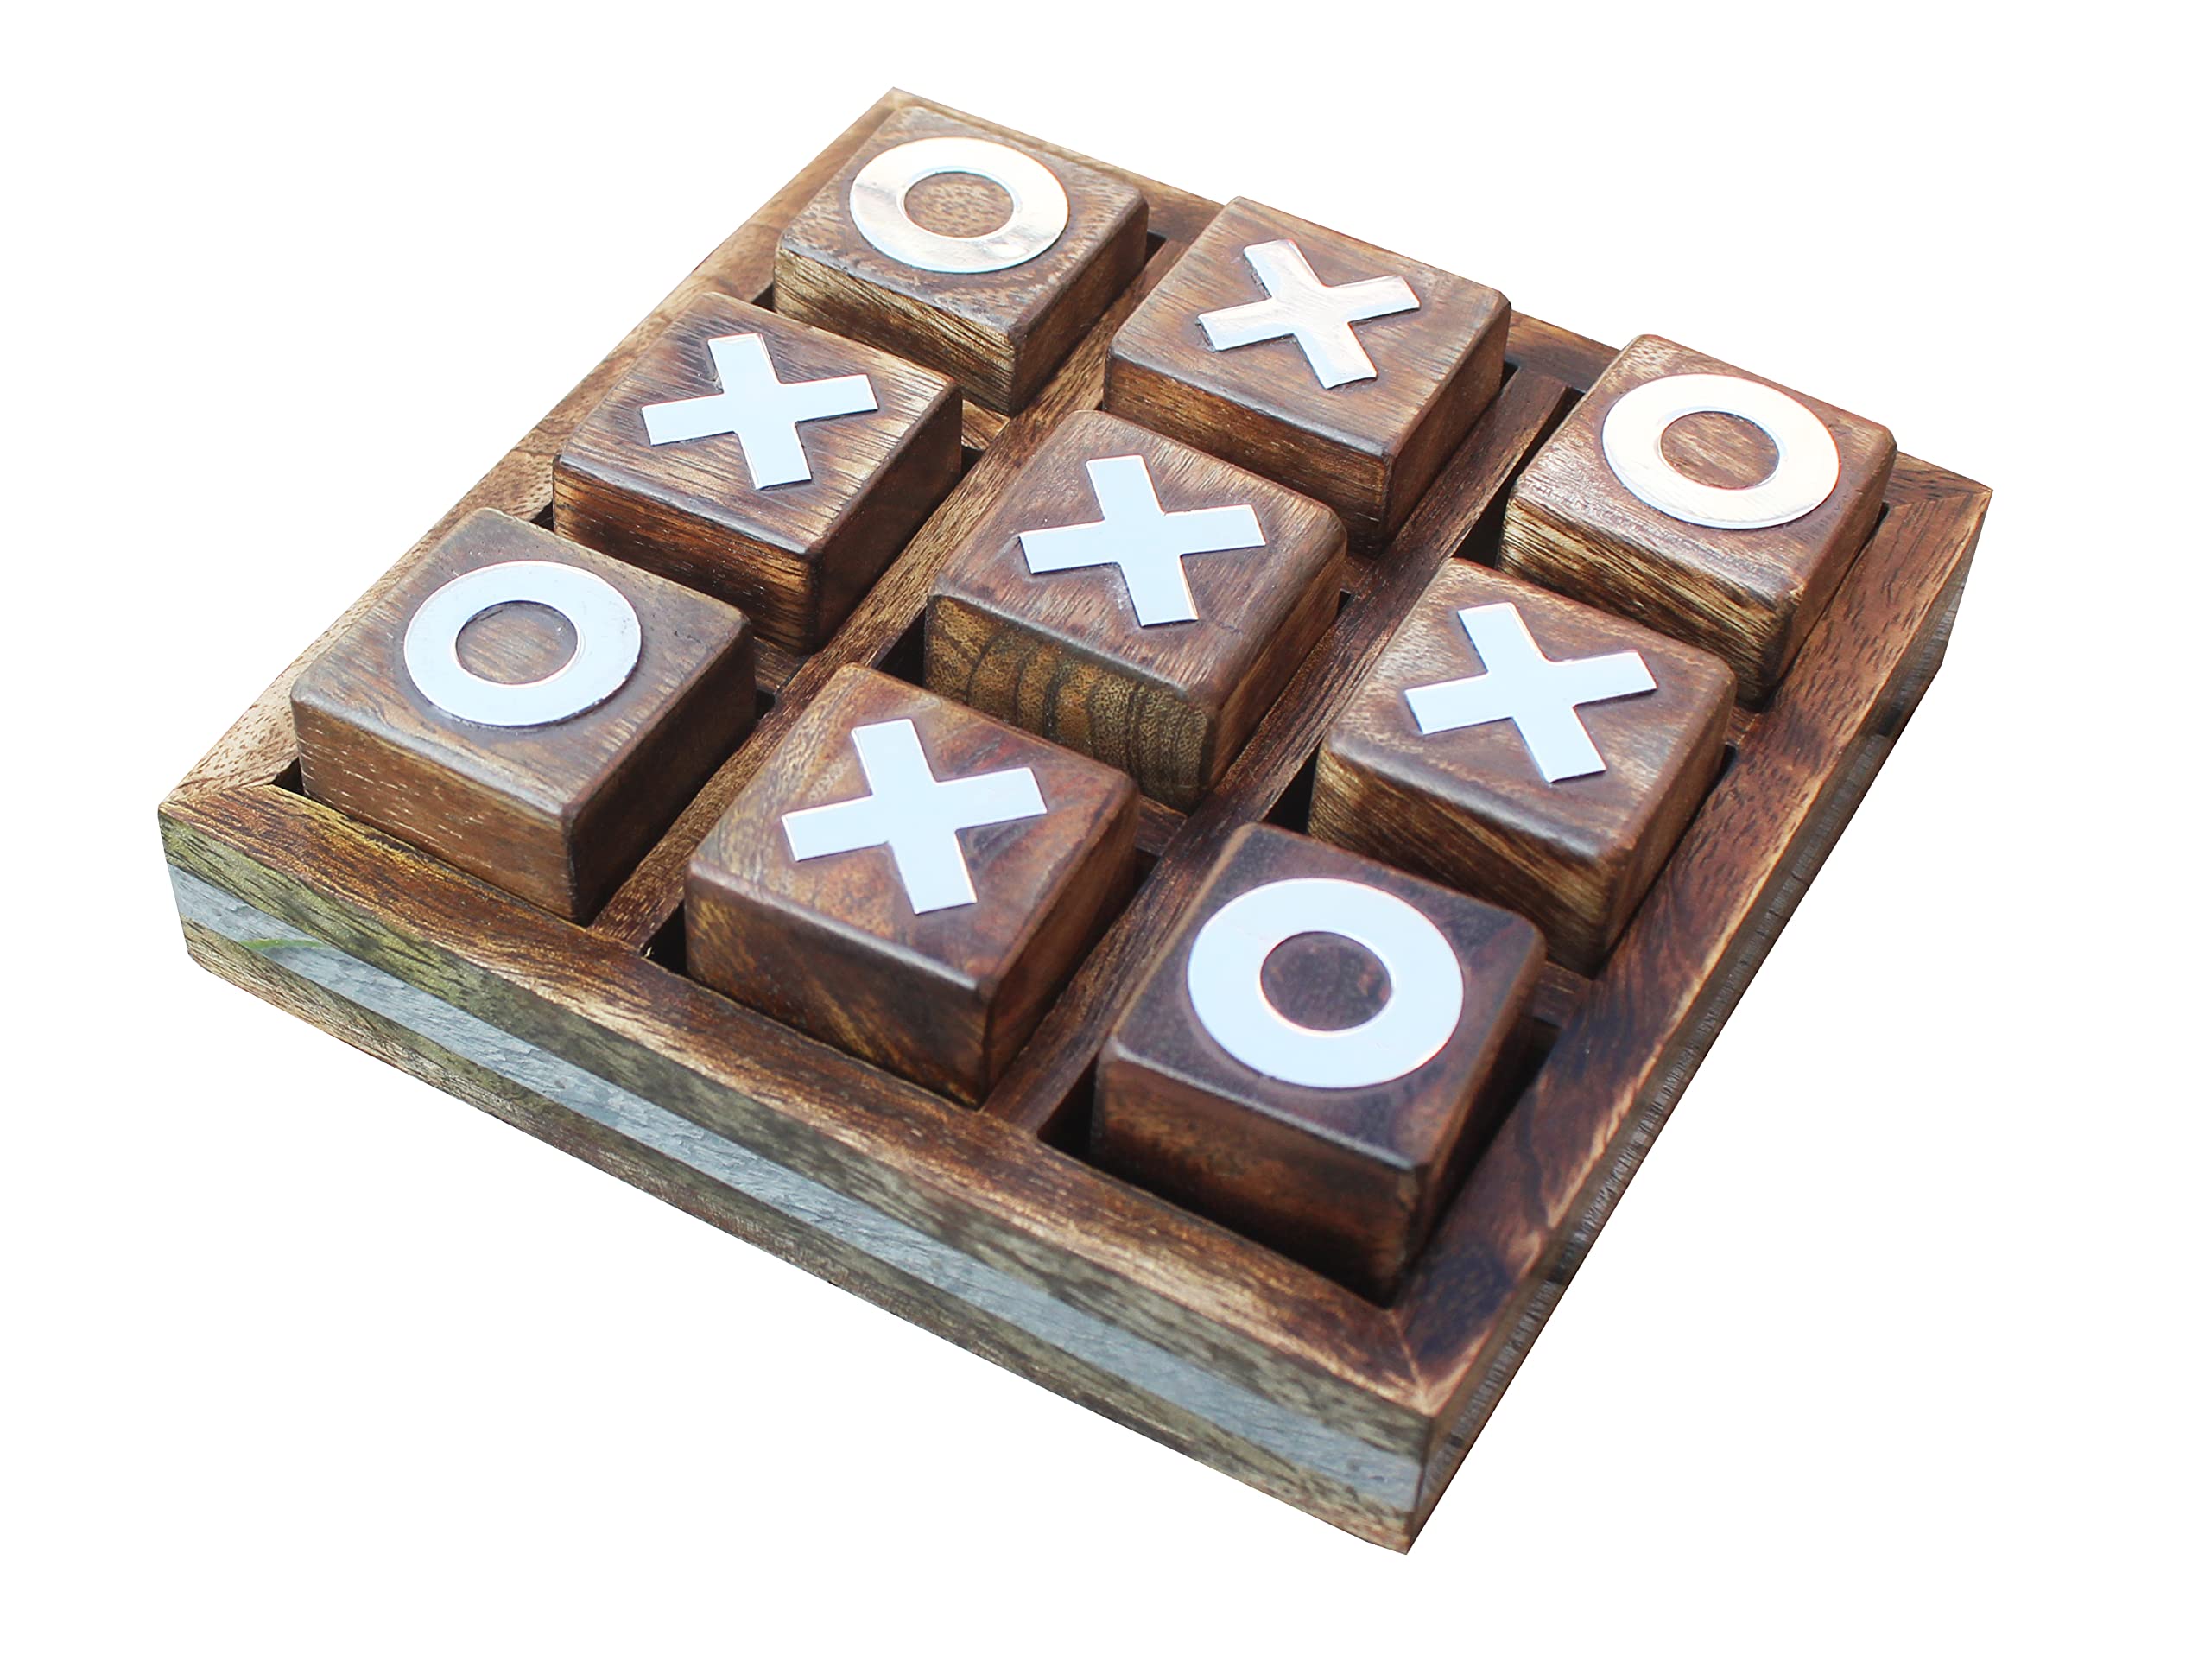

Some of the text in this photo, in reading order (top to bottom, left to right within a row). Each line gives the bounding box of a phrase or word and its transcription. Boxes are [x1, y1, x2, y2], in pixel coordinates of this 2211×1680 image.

[848, 136, 1068, 273] O
[1197, 238, 1420, 389] X
[642, 333, 878, 489] X
[1602, 373, 1840, 529] O
[1020, 454, 1266, 626] X
[403, 560, 641, 726] O
[1404, 602, 1657, 783] X
[782, 718, 1048, 914] X
[1187, 878, 1464, 1088] O
